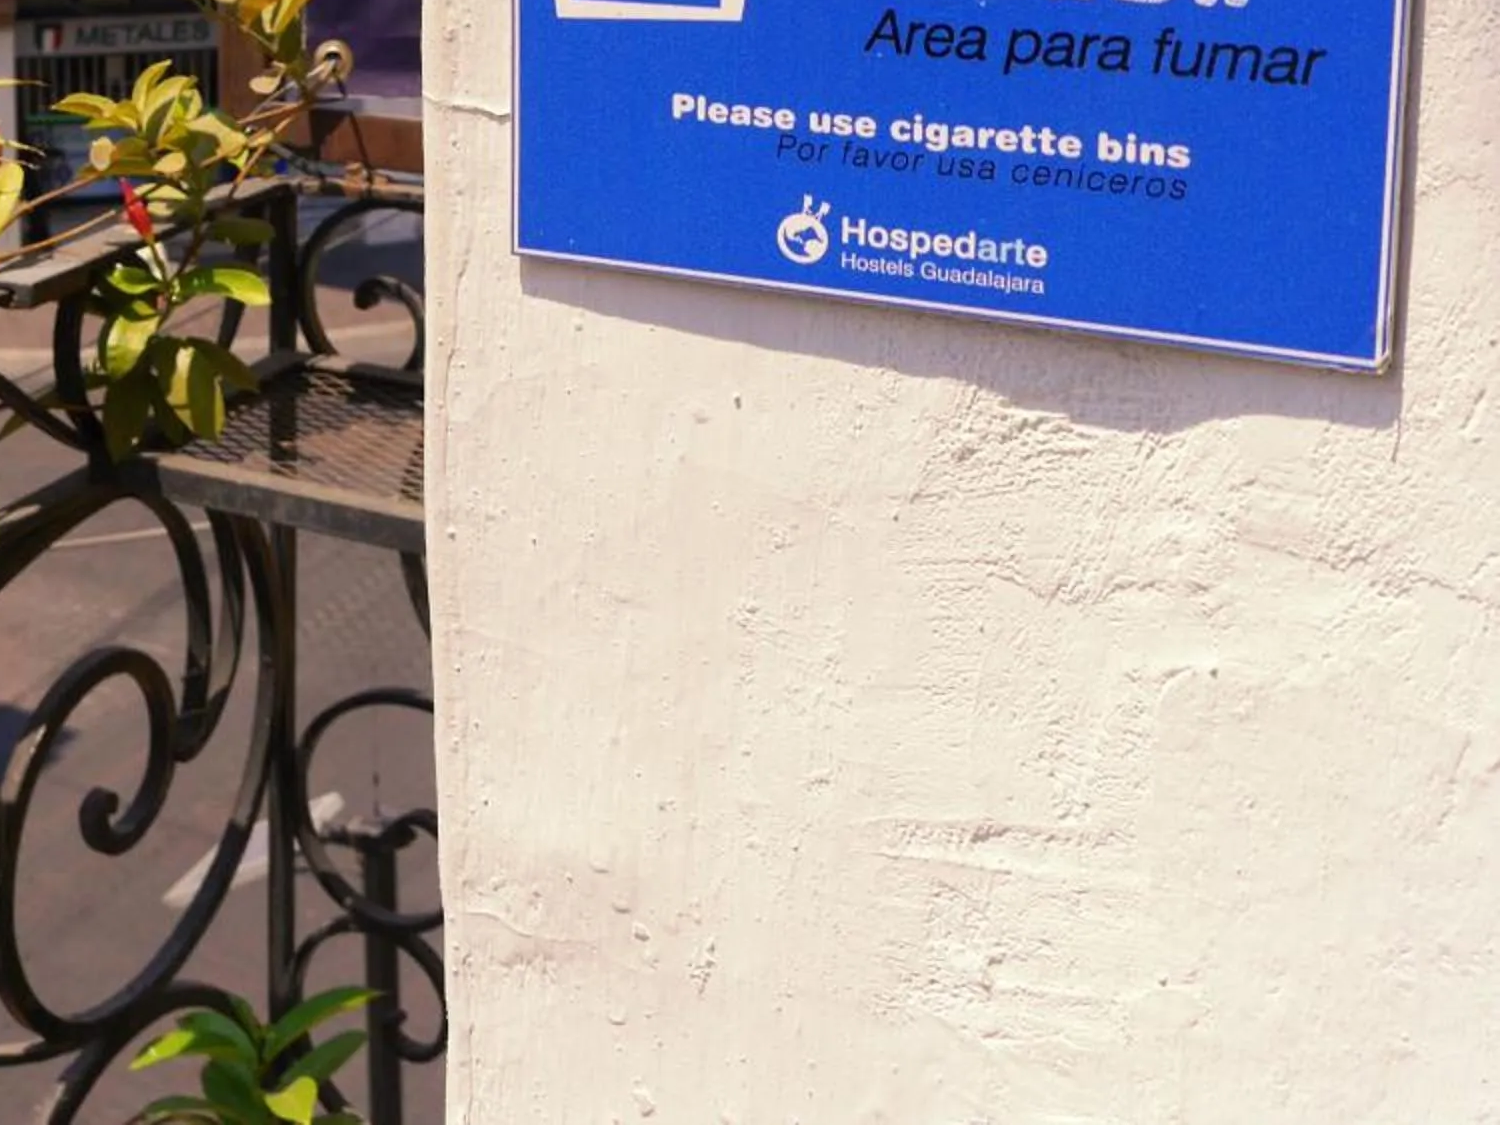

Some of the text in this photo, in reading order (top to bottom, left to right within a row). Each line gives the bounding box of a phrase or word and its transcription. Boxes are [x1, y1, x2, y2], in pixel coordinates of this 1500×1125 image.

[74, 20, 210, 47] METALES
[864, 8, 1328, 86] Area para fumar
[671, 93, 1192, 169] Please use cigarette bins
[776, 135, 1189, 201] Por favor usa ceniceros
[841, 216, 1048, 269] Hospedarte
[841, 251, 1046, 295] Hostels Guadalajara
